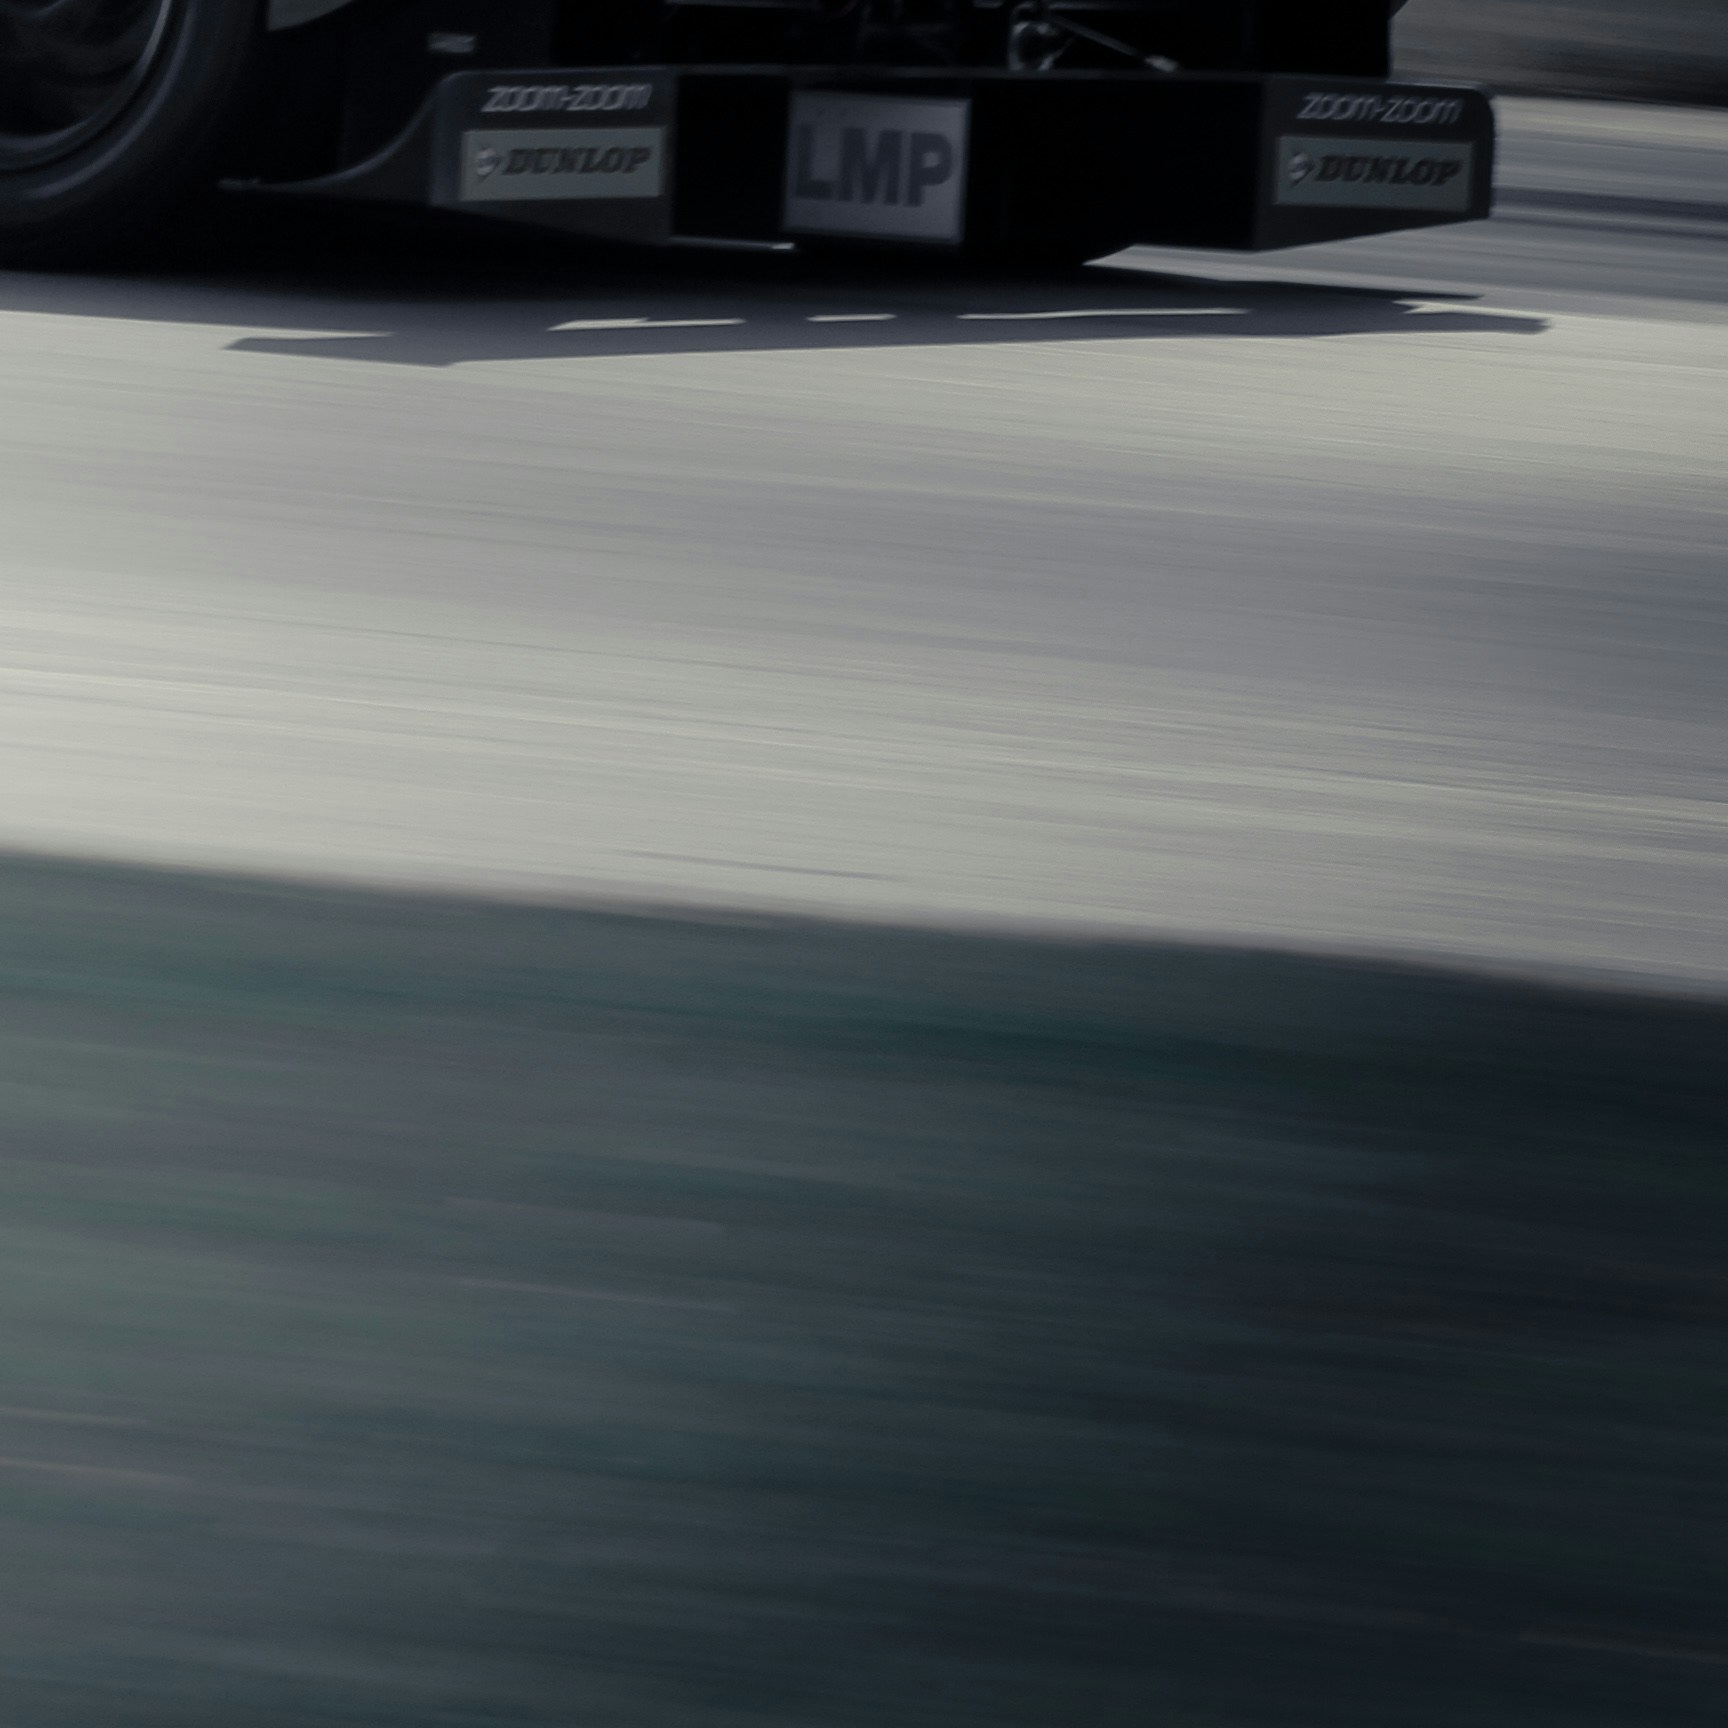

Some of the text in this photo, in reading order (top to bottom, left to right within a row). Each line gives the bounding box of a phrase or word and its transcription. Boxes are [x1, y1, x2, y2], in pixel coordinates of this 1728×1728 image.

[501, 146, 651, 176] DUNLOP
[794, 124, 954, 208] LMP
[1315, 154, 1461, 186] DUNLOP
